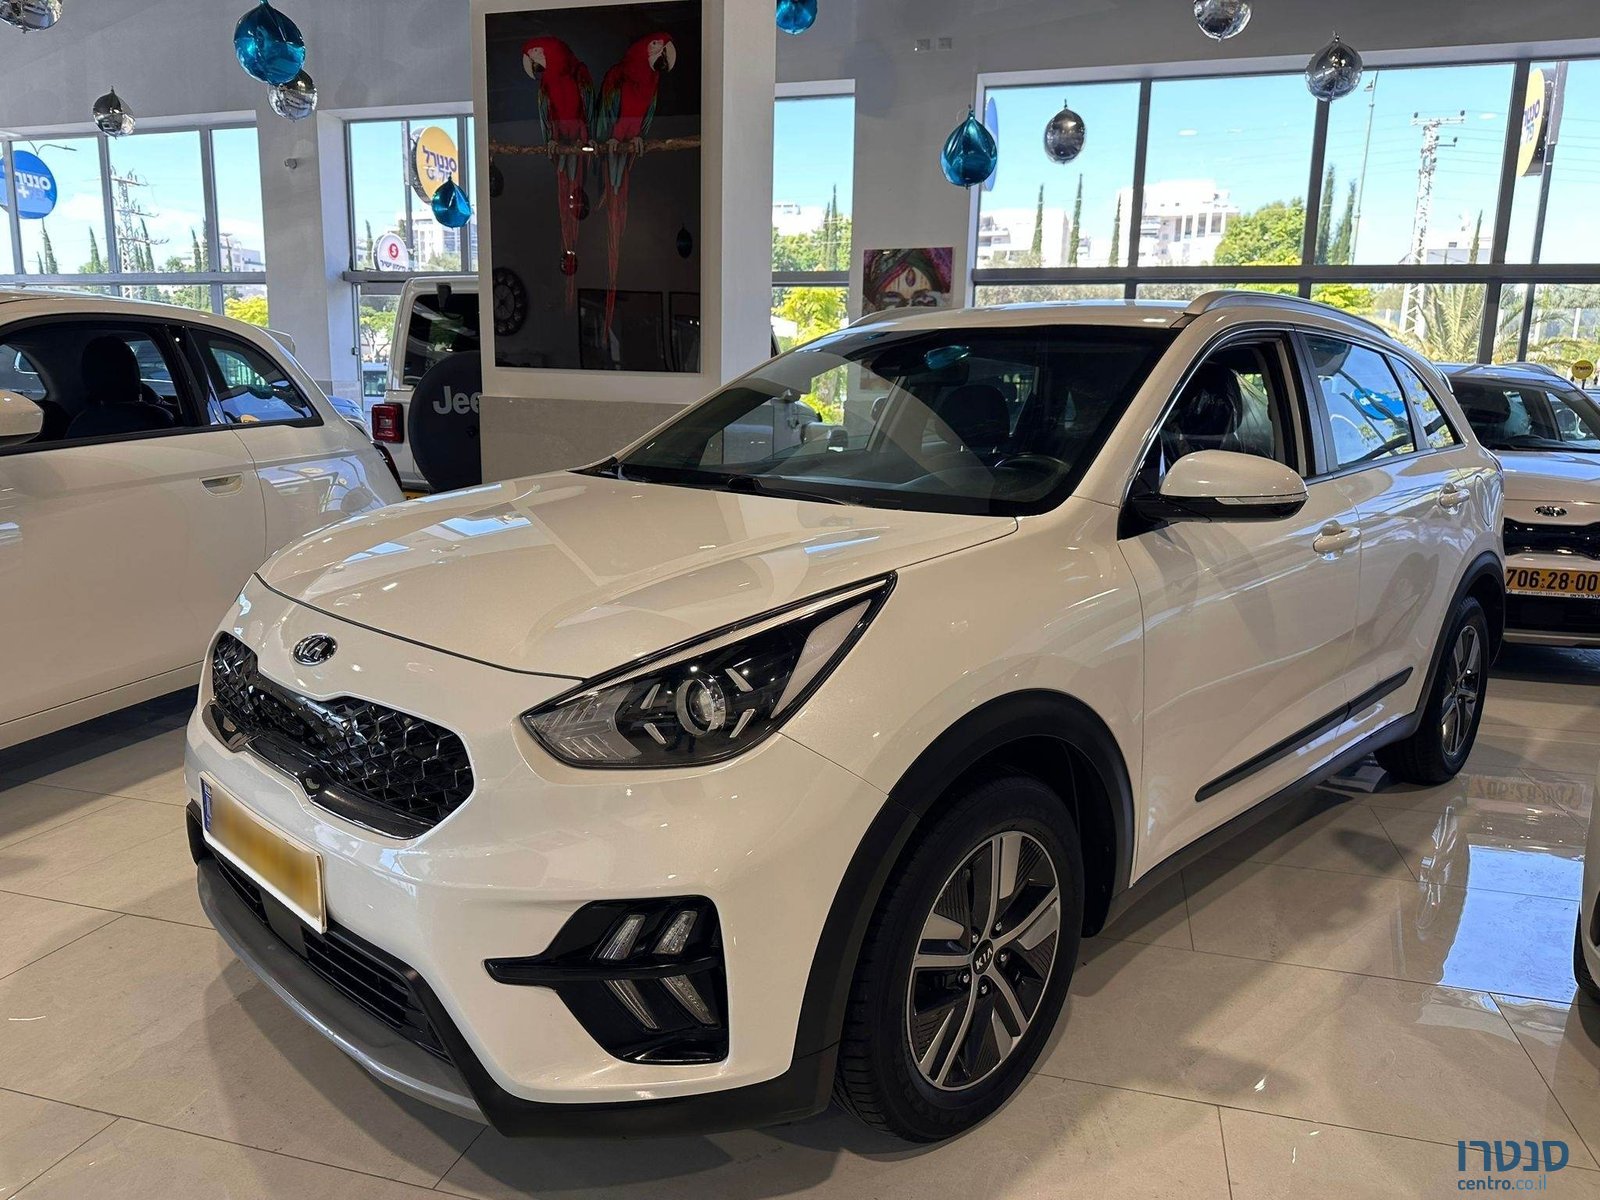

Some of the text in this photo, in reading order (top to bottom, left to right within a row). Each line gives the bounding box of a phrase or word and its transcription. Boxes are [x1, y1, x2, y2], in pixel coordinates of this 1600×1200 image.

[422, 145, 457, 173] סנטרל
[13, 170, 52, 191] סנטר
[975, 947, 993, 970] KIA
